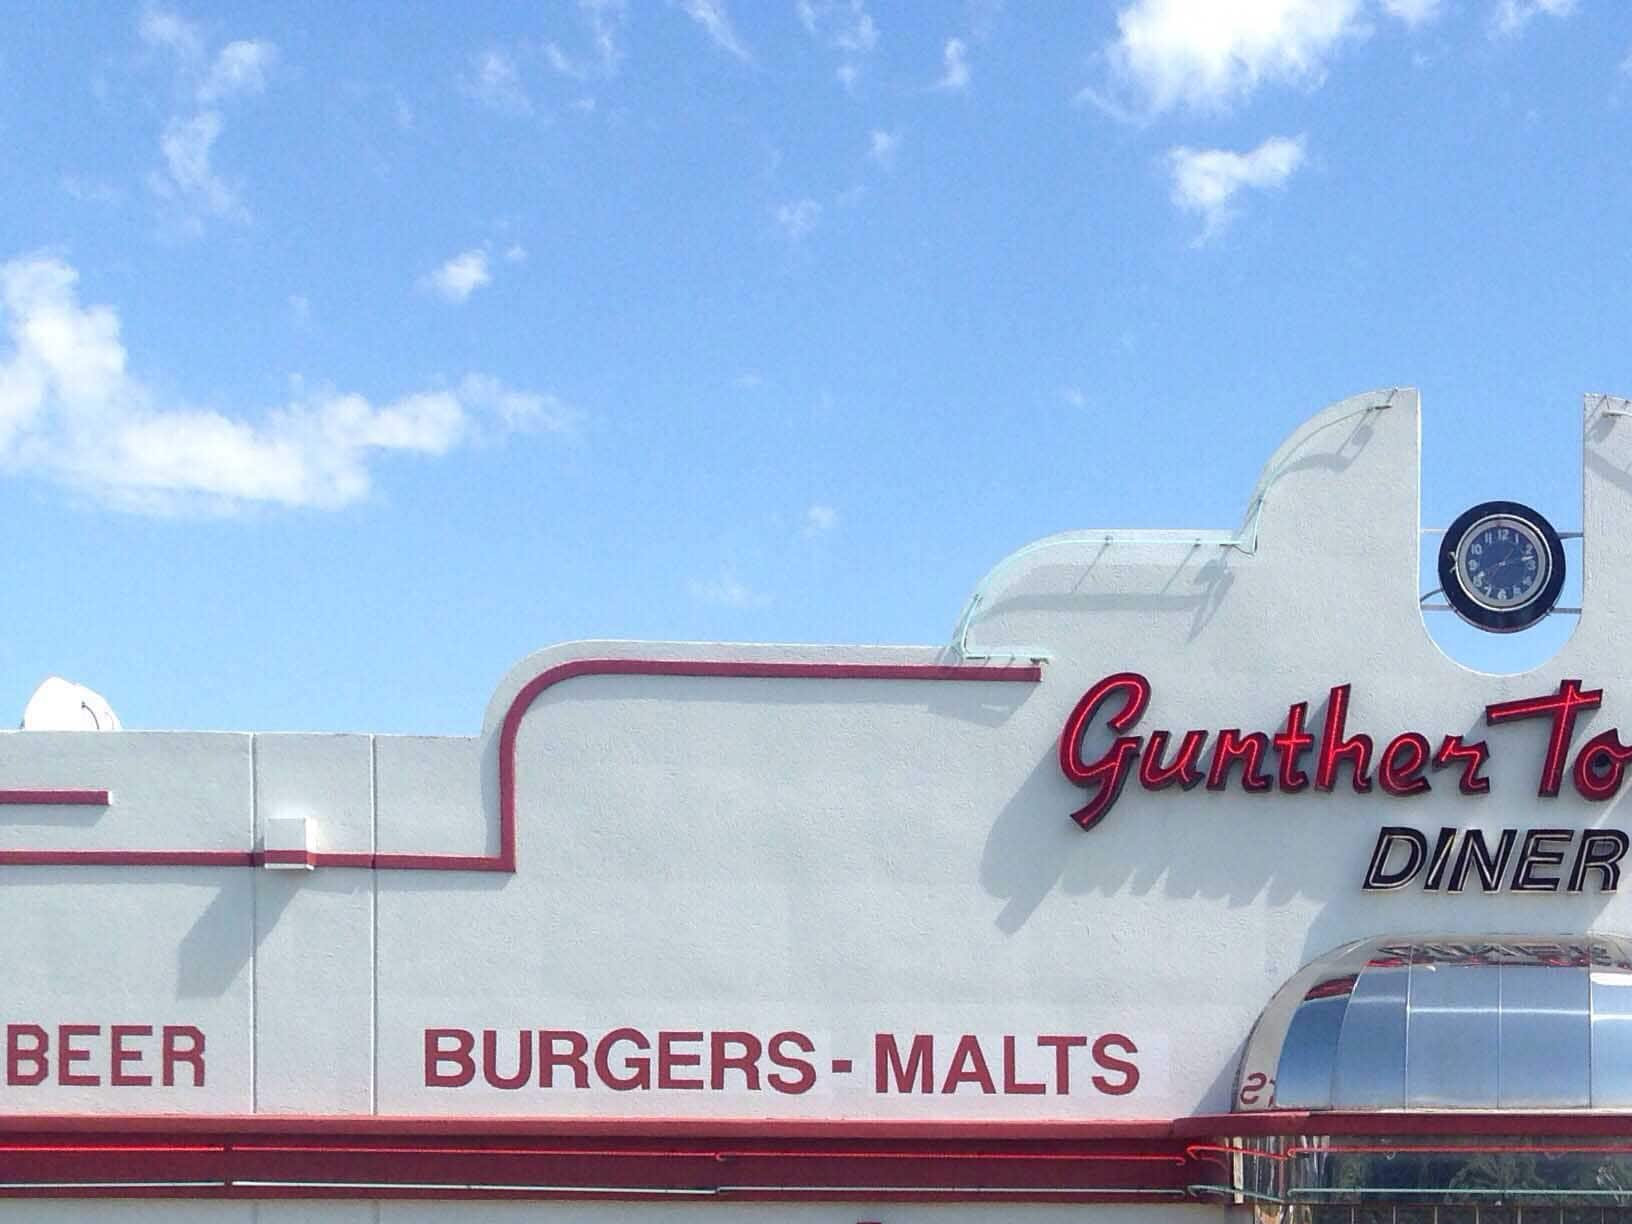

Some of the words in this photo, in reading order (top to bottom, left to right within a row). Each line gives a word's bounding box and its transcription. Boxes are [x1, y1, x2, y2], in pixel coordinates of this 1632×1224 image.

[1484, 532, 1492, 544] 11
[1498, 529, 1509, 540] 12
[1471, 543, 1482, 555] 10
[1525, 544, 1533, 555] 2
[1058, 672, 1490, 832] Gunther
[1361, 826, 1630, 895] DINER
[7, 1024, 204, 1085] BEER
